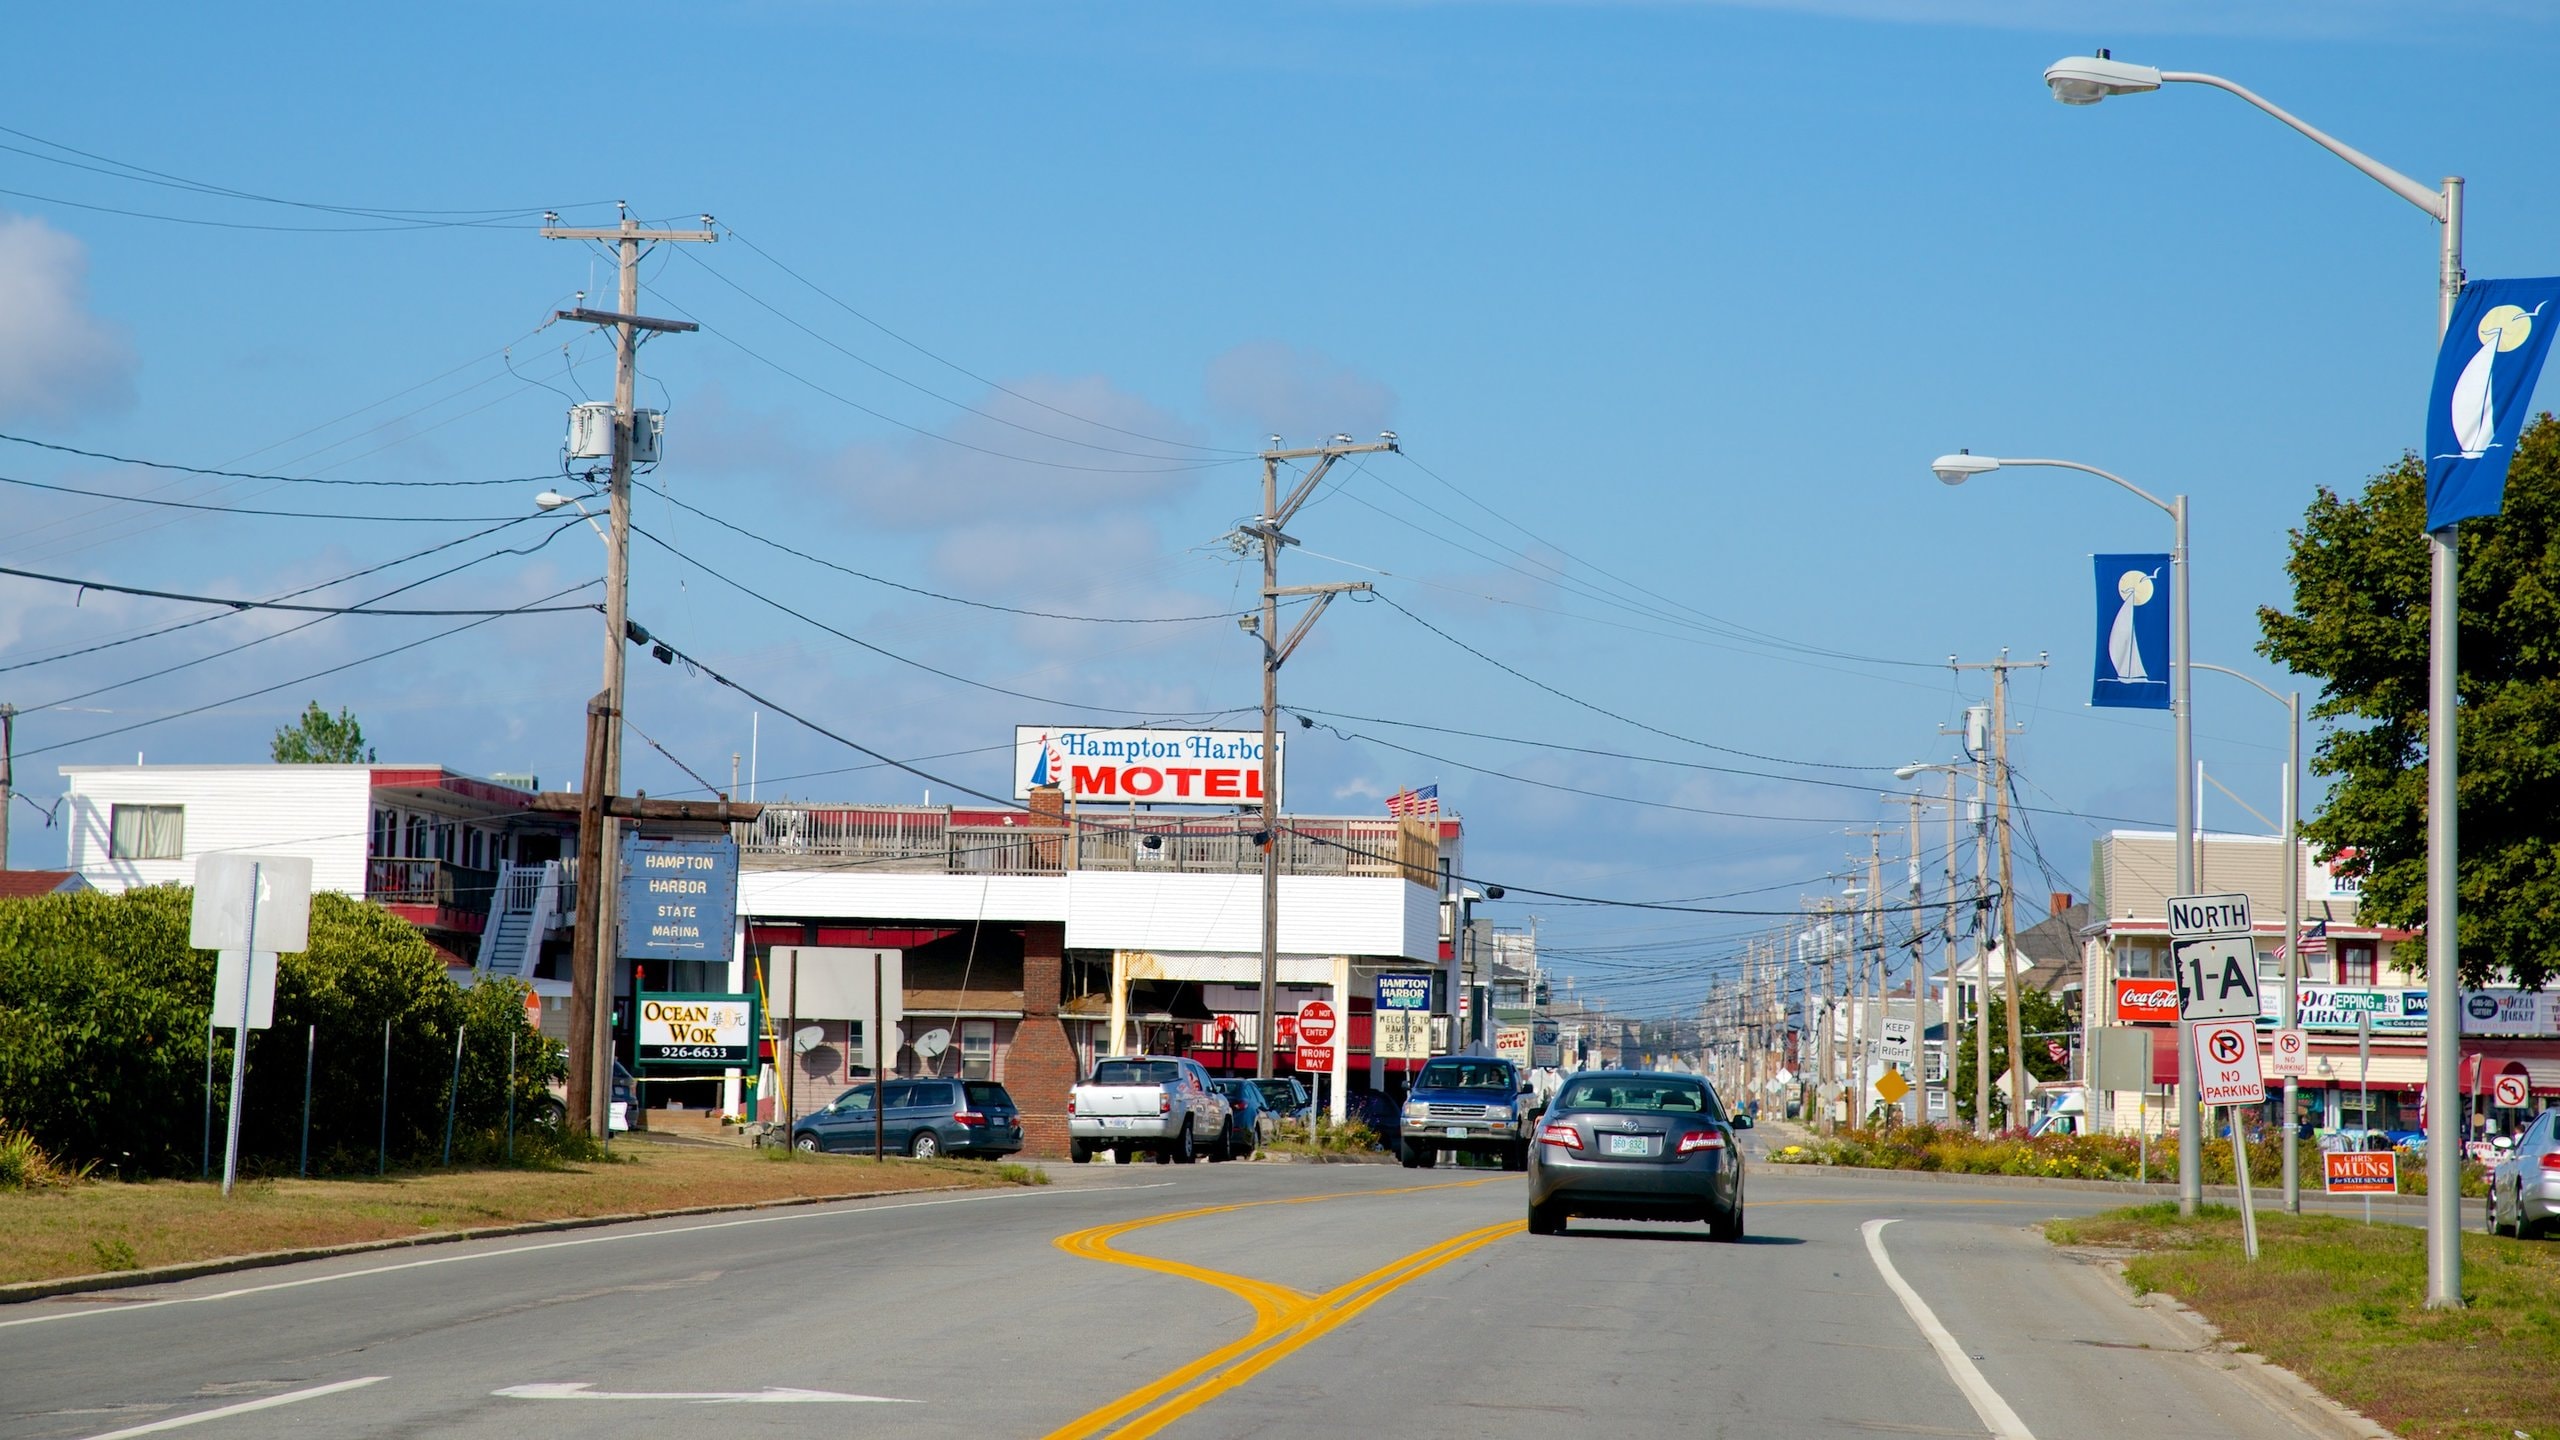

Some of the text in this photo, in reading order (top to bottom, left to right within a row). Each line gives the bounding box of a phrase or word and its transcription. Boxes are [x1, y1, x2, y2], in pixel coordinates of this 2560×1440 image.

[1061, 733, 1279, 763] Hampton Harbo
[1072, 765, 1264, 798] MOTEL
[646, 855, 714, 870] HAMPTON
[649, 880, 707, 893] HARBOR
[658, 905, 697, 918] STATE
[2173, 903, 2246, 930] NORTH
[652, 925, 700, 938] MARINA
[1379, 978, 1428, 989] HAMPTON
[2189, 955, 2254, 1001] 1-A
[1382, 988, 1425, 999] HARBOR
[2121, 988, 2178, 1008] Coca-Cola
[2336, 994, 2374, 1010] EPPING
[644, 1002, 709, 1021] OCEAN
[1304, 1009, 1331, 1017] DO NOT
[2501, 1010, 2535, 1022] MARKET
[1420, 1016, 1430, 1025] TO
[669, 1023, 717, 1043] WOK
[1306, 1028, 1328, 1037] ENTER
[1885, 1022, 1910, 1033] KEEP
[1388, 1034, 1416, 1042] BEAH
[661, 1046, 728, 1059] 926-6633
[1301, 1048, 1331, 1058] WRONG
[1385, 1043, 1394, 1052] BE
[1882, 1046, 1909, 1057] RIGHT
[1306, 1059, 1325, 1069] WAY
[2275, 1064, 2305, 1072] PARKING
[2222, 1070, 2240, 1082] NO
[2207, 1084, 2260, 1099] PARKING
[2334, 1162, 2390, 1177] MUNS
